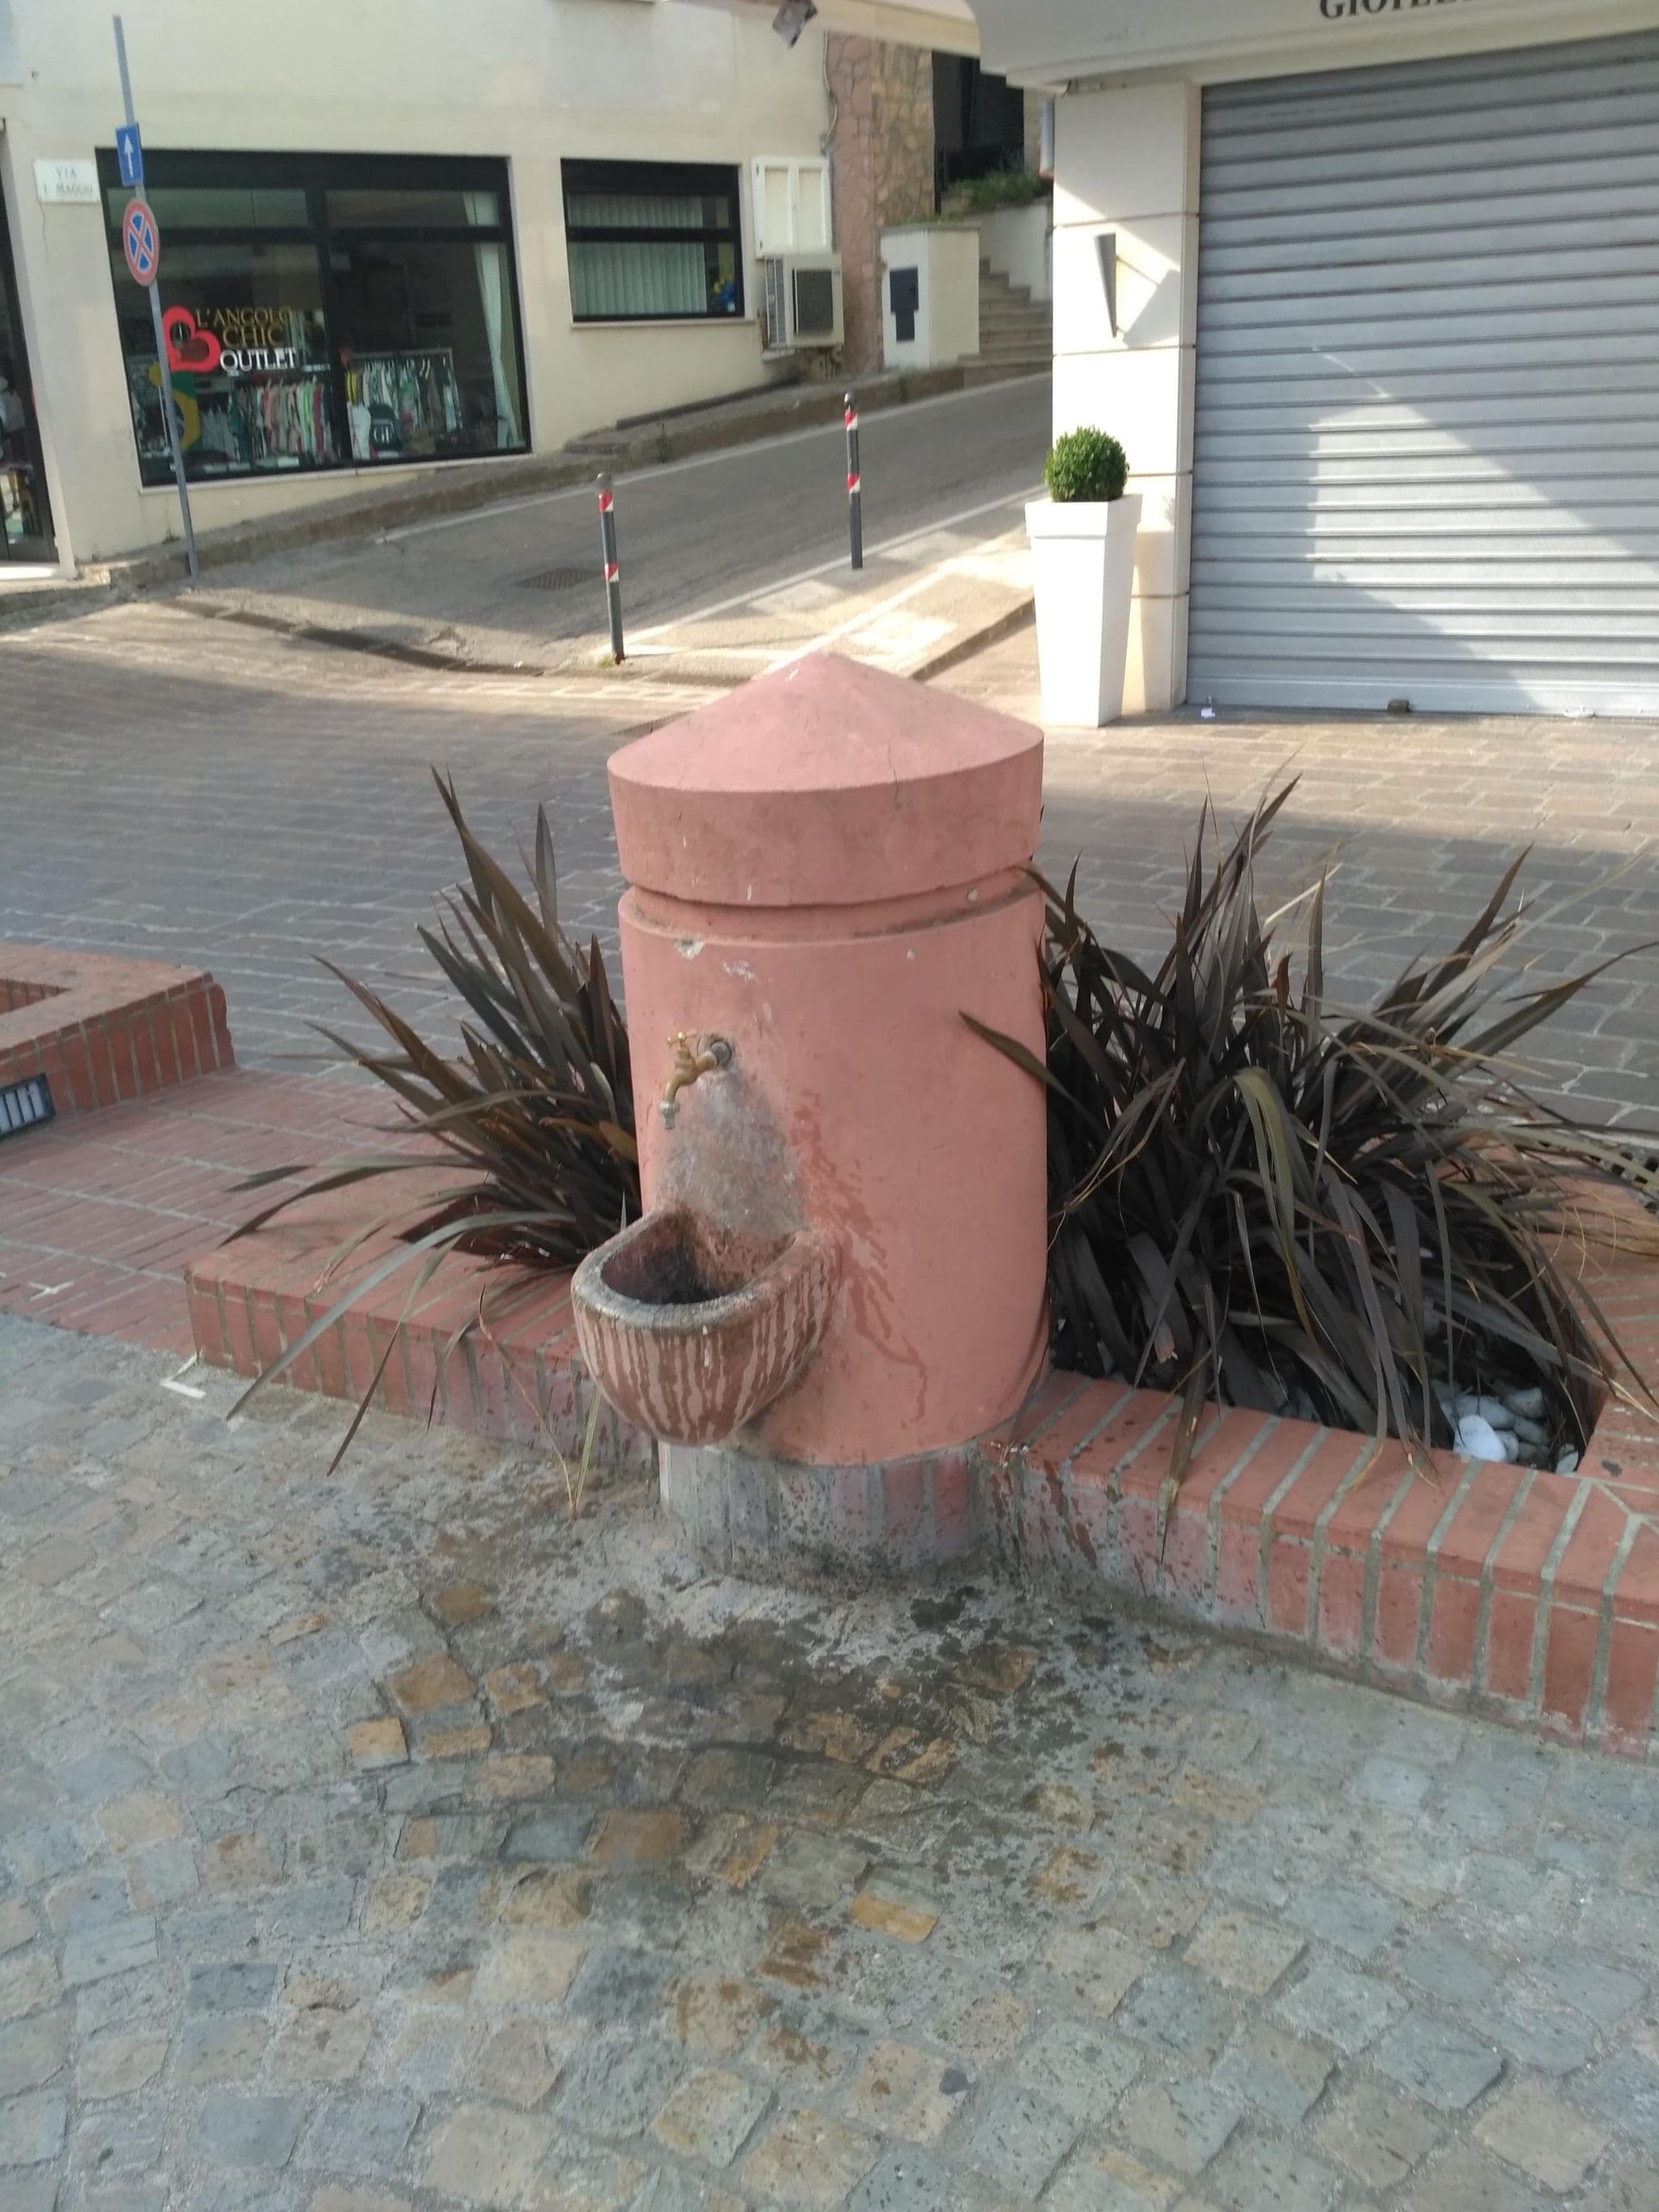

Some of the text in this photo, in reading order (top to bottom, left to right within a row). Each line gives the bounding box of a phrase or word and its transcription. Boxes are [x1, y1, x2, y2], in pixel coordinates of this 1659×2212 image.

[55, 167, 77, 178] VIA
[196, 305, 292, 327] L'ANGOLO
[222, 325, 284, 348] CHIC
[220, 347, 296, 371] OUTLET
